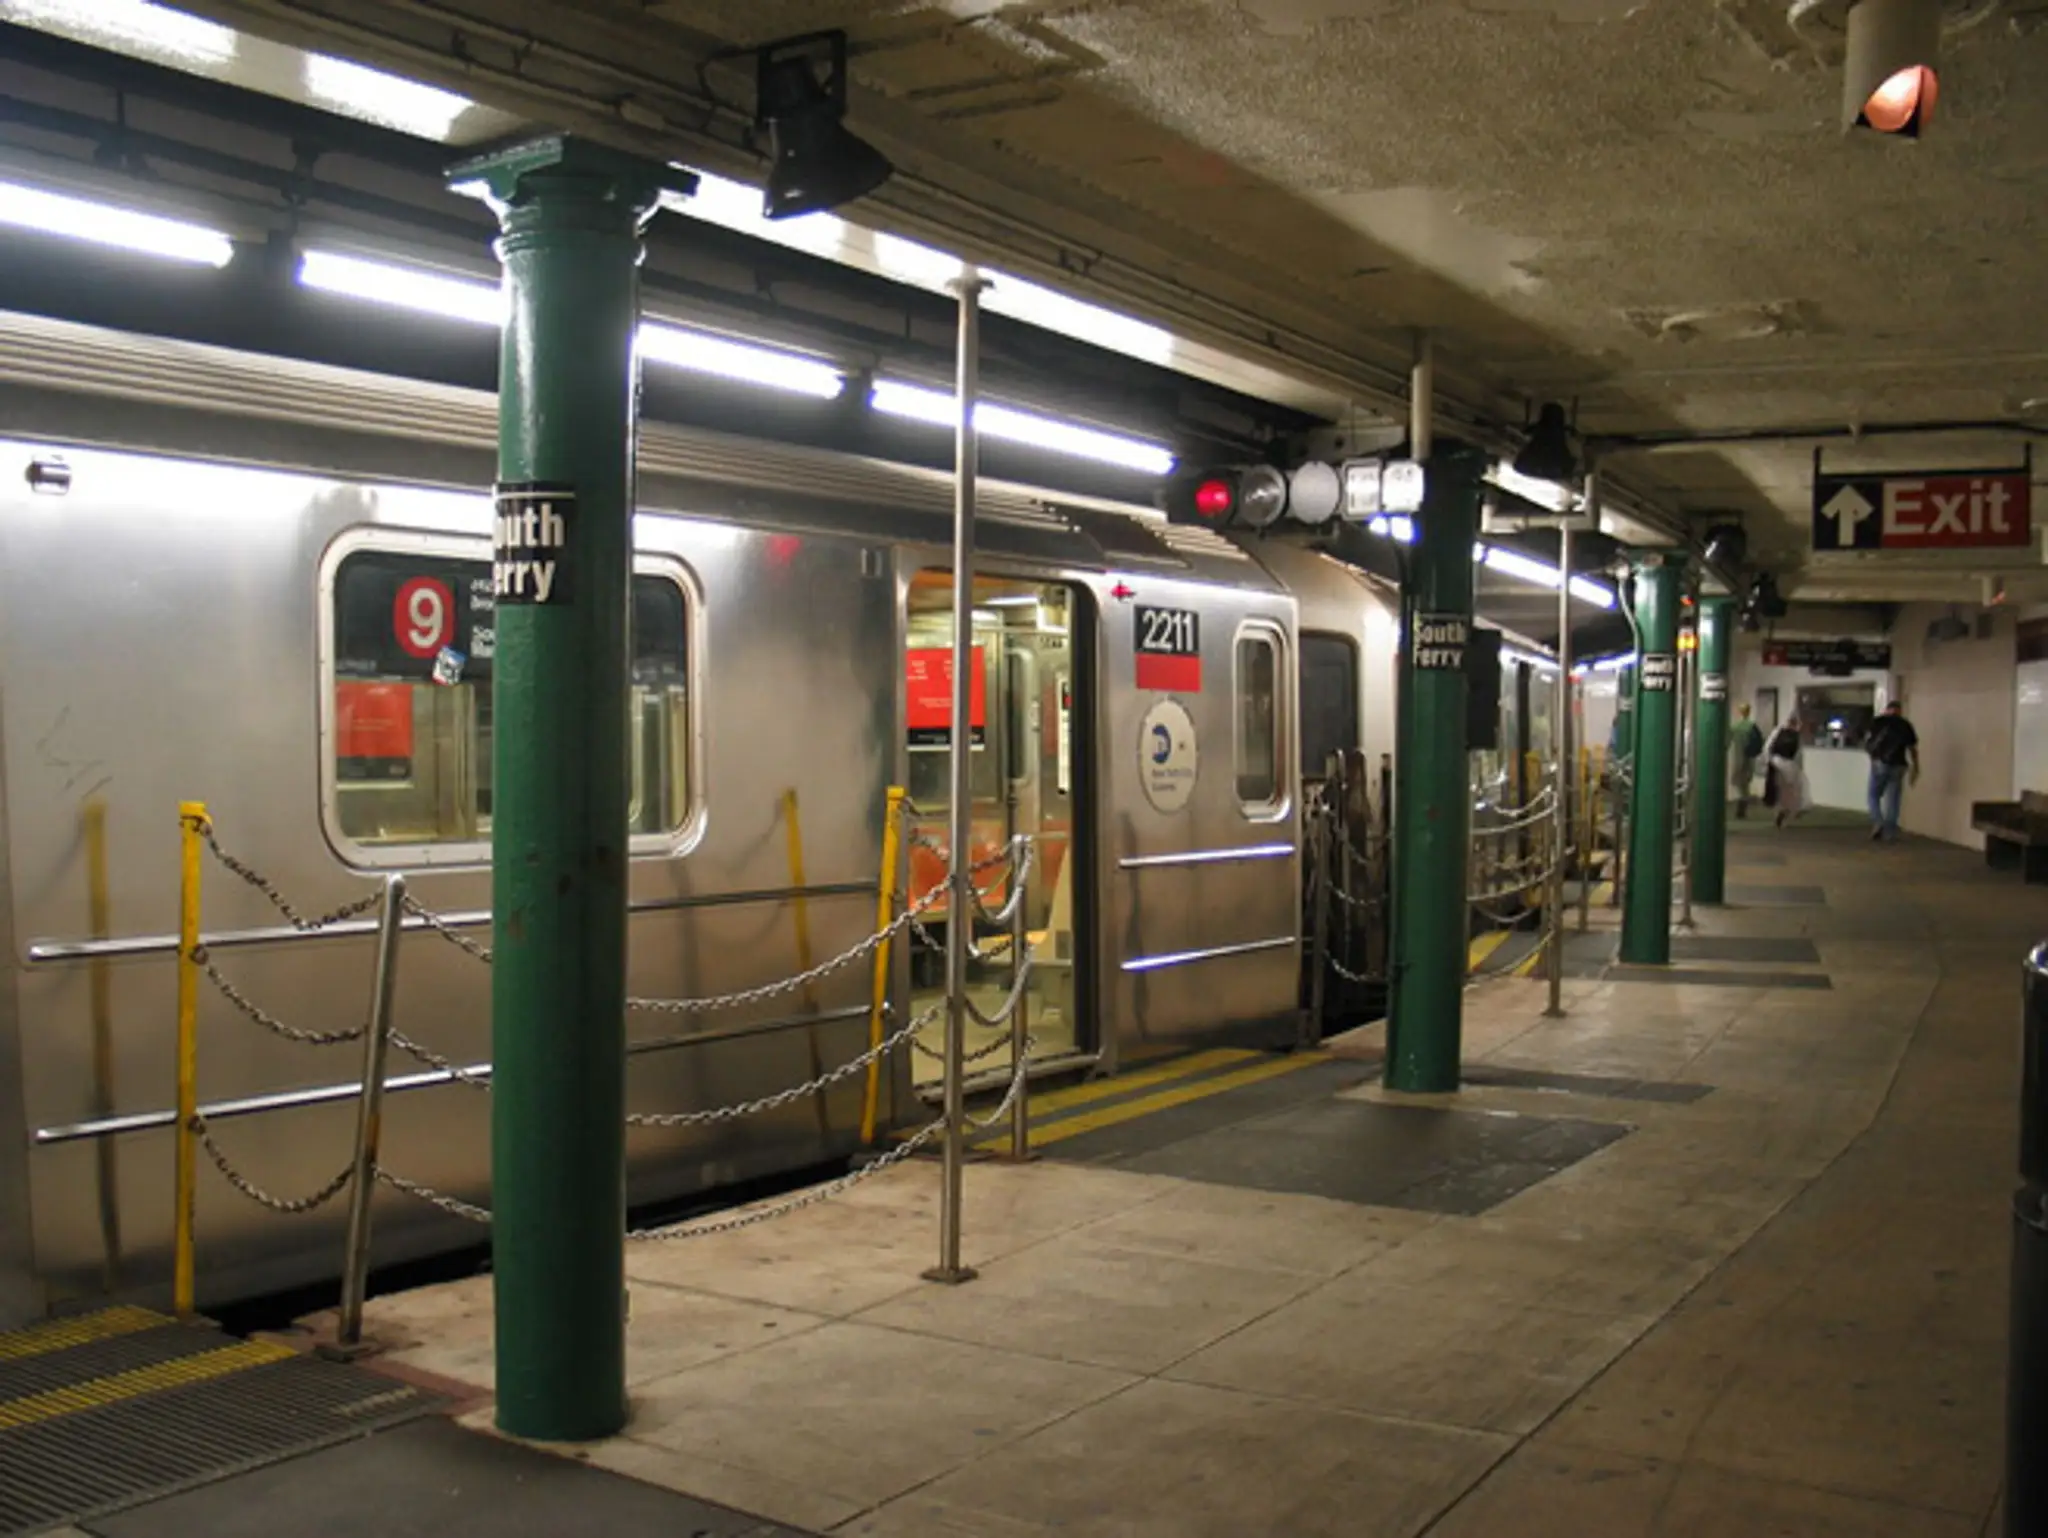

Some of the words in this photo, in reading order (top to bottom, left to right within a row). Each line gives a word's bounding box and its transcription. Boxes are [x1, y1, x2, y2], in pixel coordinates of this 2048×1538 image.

[1883, 479, 2012, 535] Exit
[408, 587, 444, 649] 9
[1142, 609, 1194, 652] 2211
[1412, 621, 1467, 644] South
[1412, 644, 1464, 670] Ferry
